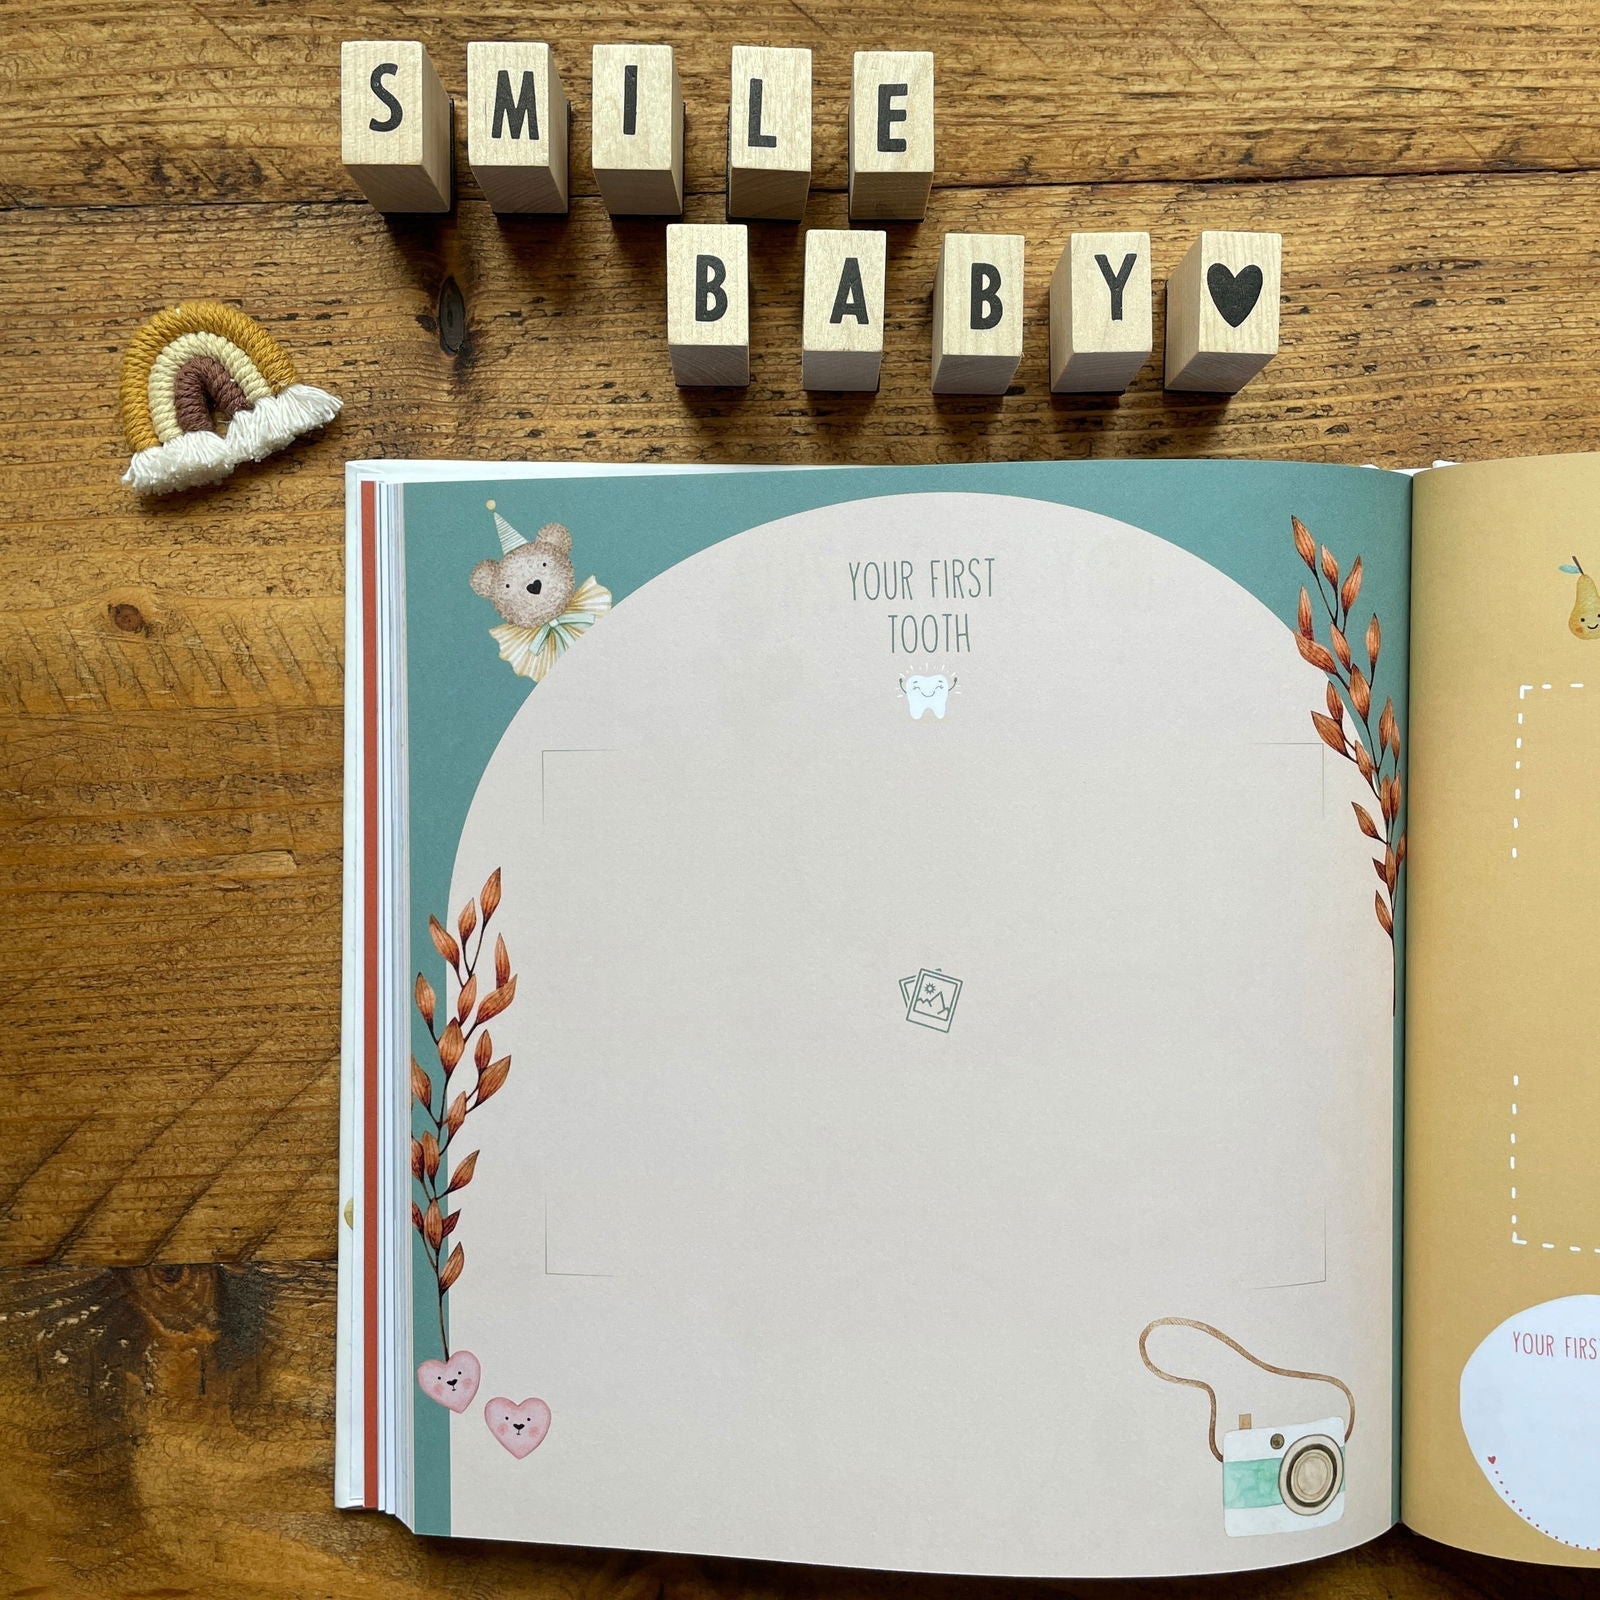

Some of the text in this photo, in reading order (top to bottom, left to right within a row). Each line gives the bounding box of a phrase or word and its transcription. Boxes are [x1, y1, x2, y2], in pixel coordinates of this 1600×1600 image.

[369, 63, 908, 153] SMILE
[694, 253, 1137, 331] BABY
[849, 557, 996, 601] YOUR FIRST
[887, 613, 971, 654] TOOTH
[1512, 1331, 1600, 1360] YOUR FIRS
